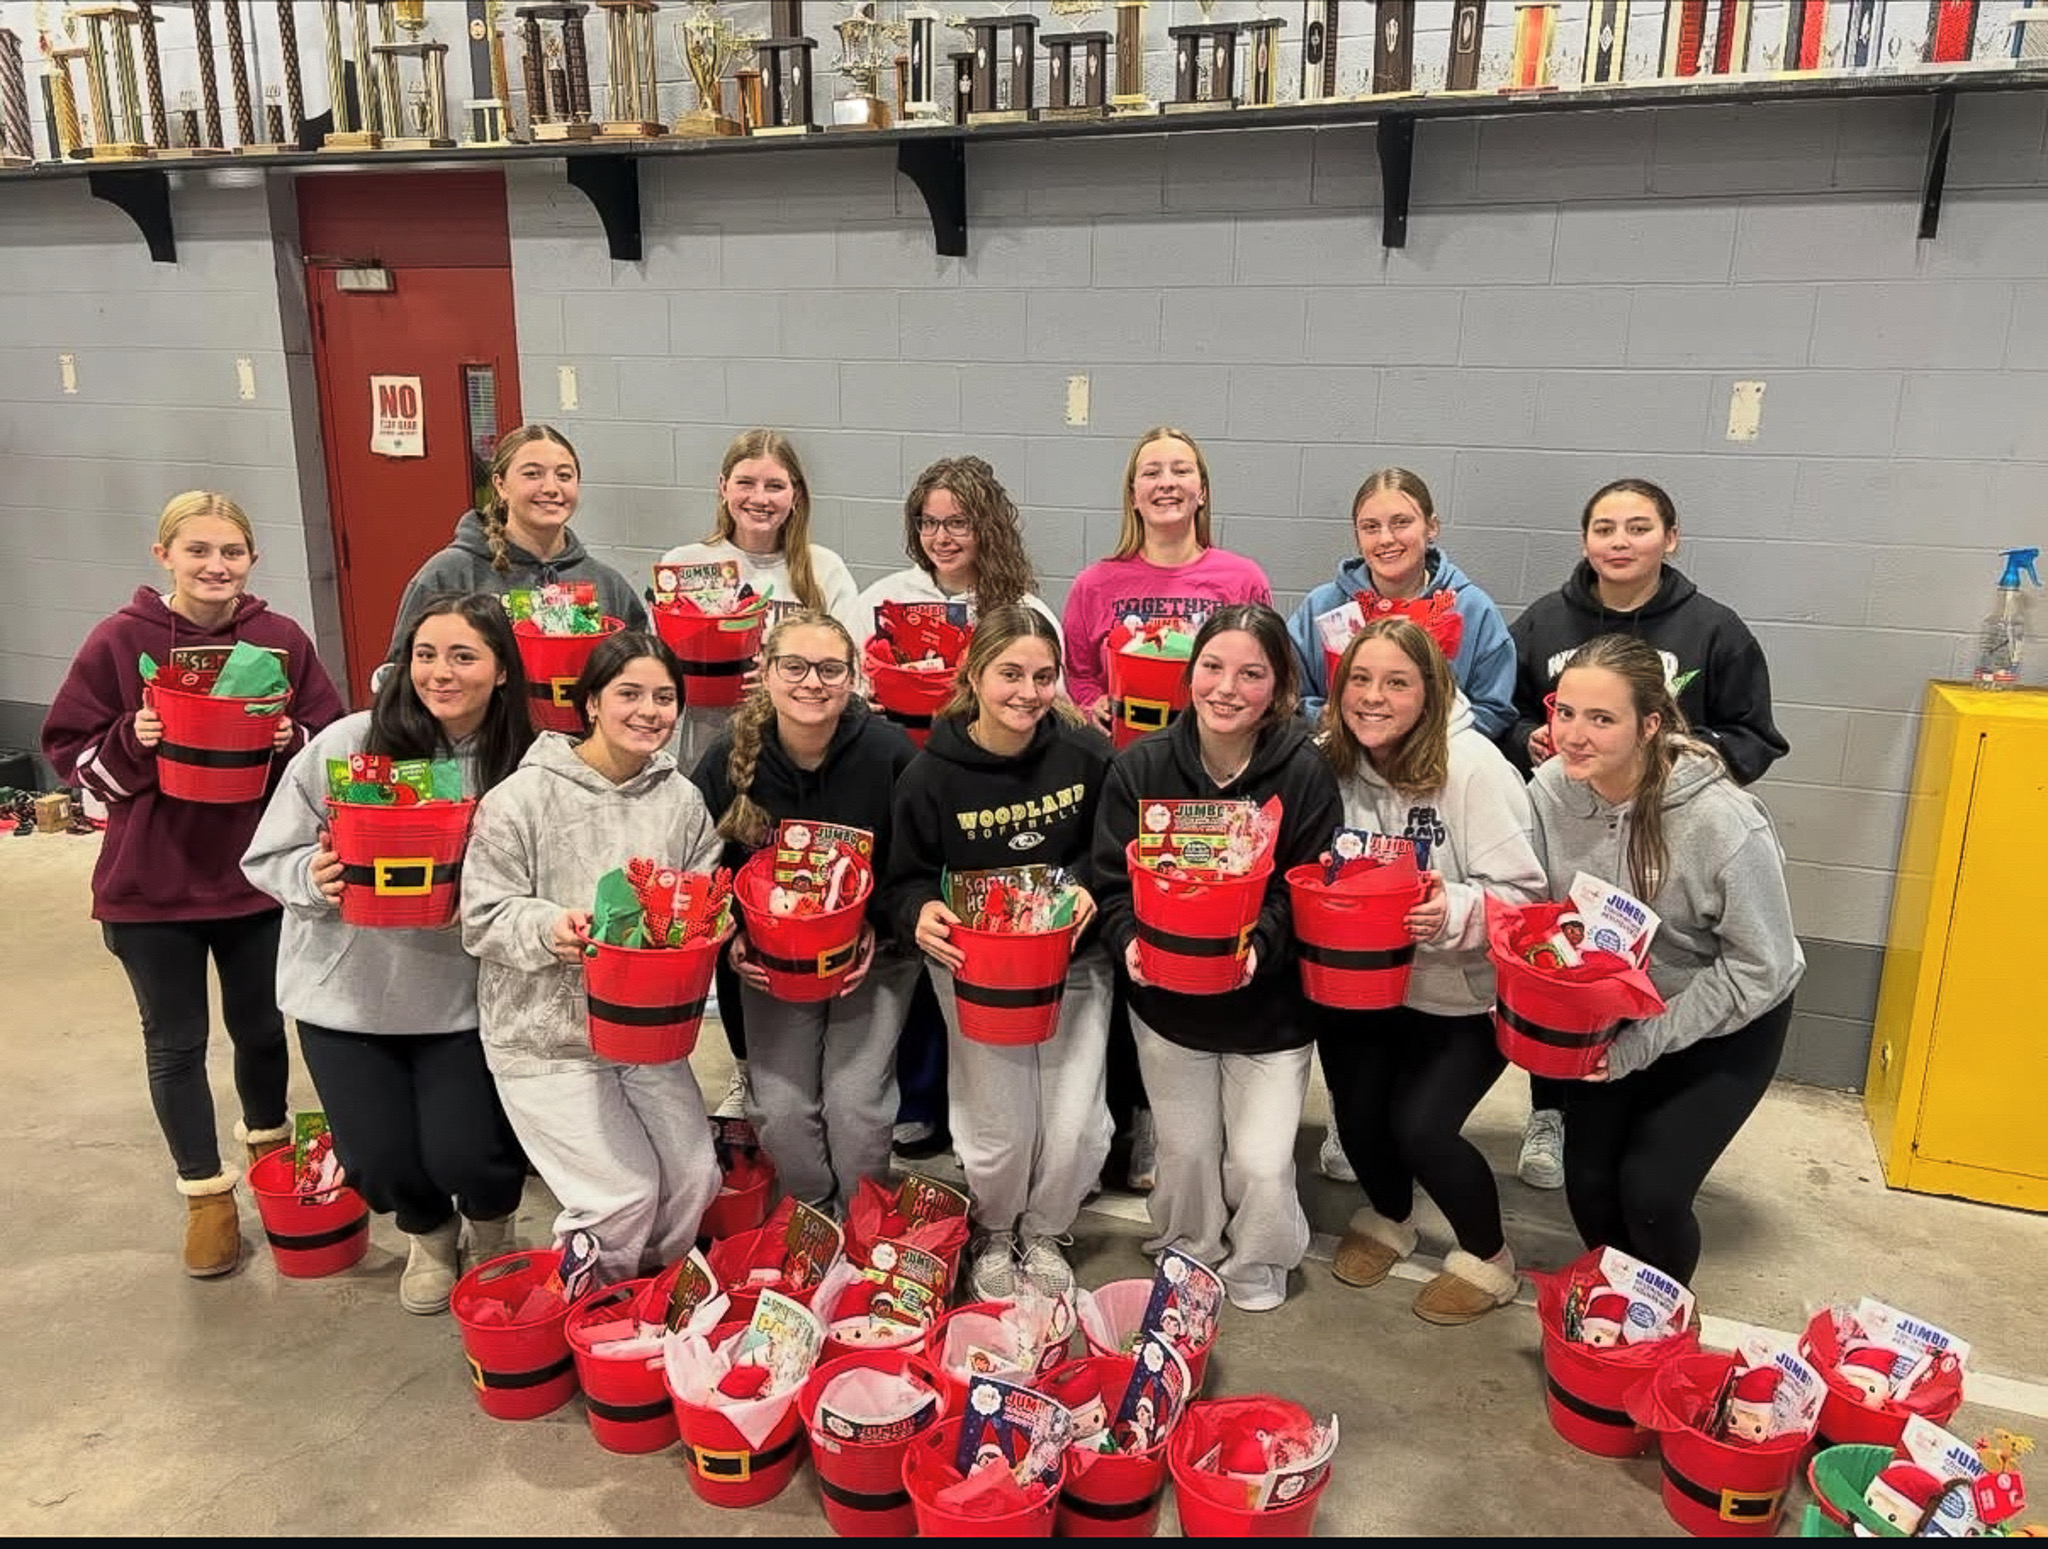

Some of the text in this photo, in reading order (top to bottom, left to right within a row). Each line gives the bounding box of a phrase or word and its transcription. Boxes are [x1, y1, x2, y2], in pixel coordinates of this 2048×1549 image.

[379, 385, 417, 418] NO
[957, 784, 1085, 830] WOODLAND
[967, 805, 1079, 840] SOFTBALL
[1606, 894, 1647, 926] JUMBO
[1636, 1268, 1679, 1300] JUMBO
[1896, 1319, 1949, 1350] JUMBO
[1947, 1447, 1984, 1478] JUM
